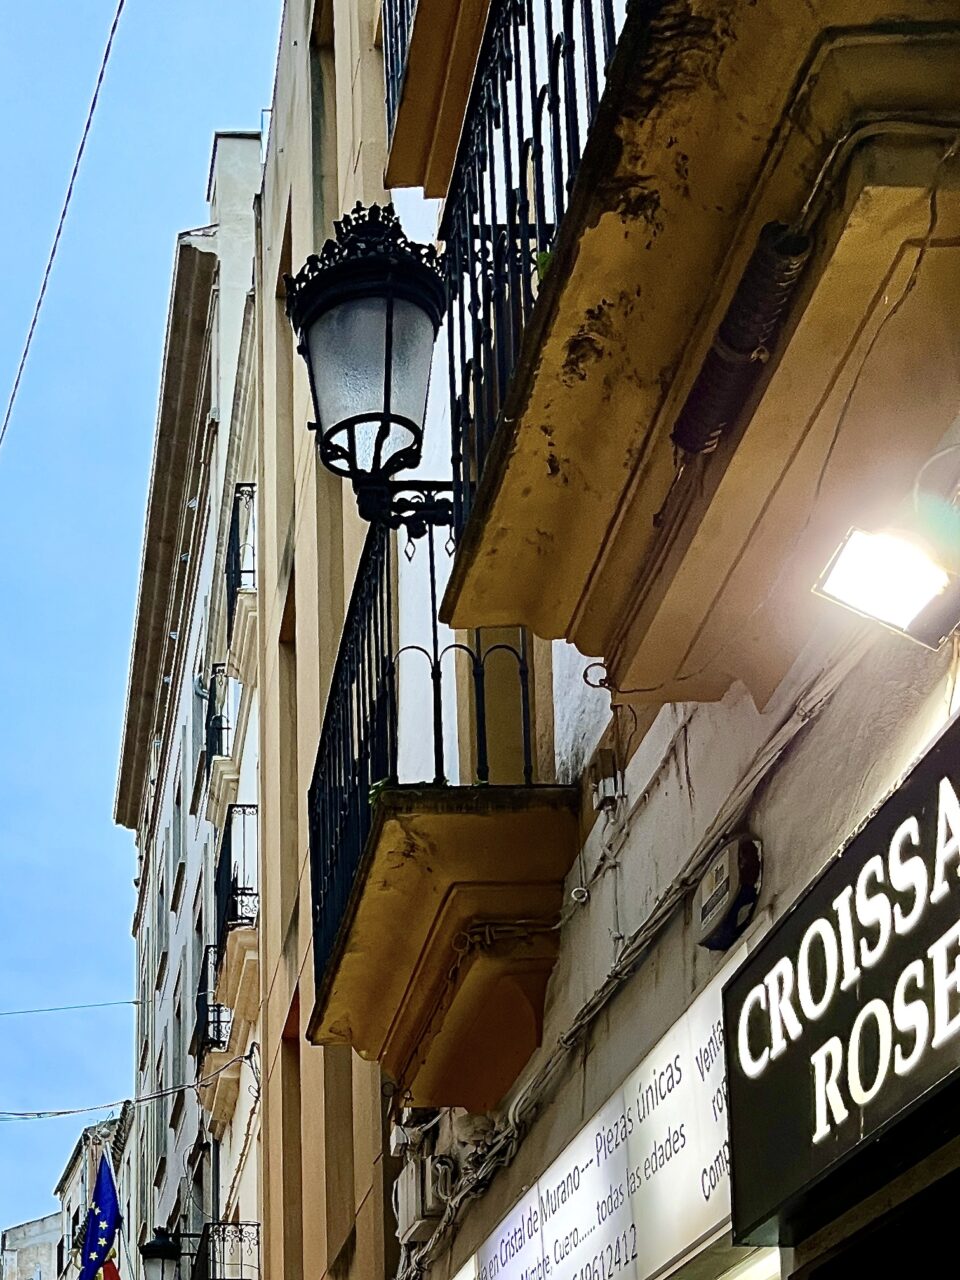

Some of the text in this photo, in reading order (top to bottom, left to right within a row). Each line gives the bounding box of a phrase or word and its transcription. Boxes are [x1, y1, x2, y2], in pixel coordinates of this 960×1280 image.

[738, 776, 960, 1080] CROISSA
[809, 924, 960, 1144] ROSE
[488, 1254, 499, 1280] en
[500, 1215, 526, 1267] Cristal
[527, 1209, 539, 1243] de
[595, 1106, 633, 1167] Piezas
[636, 1055, 683, 1124] únicas
[596, 1184, 625, 1225] todas
[626, 1164, 642, 1198] las
[644, 1122, 687, 1178] edades
